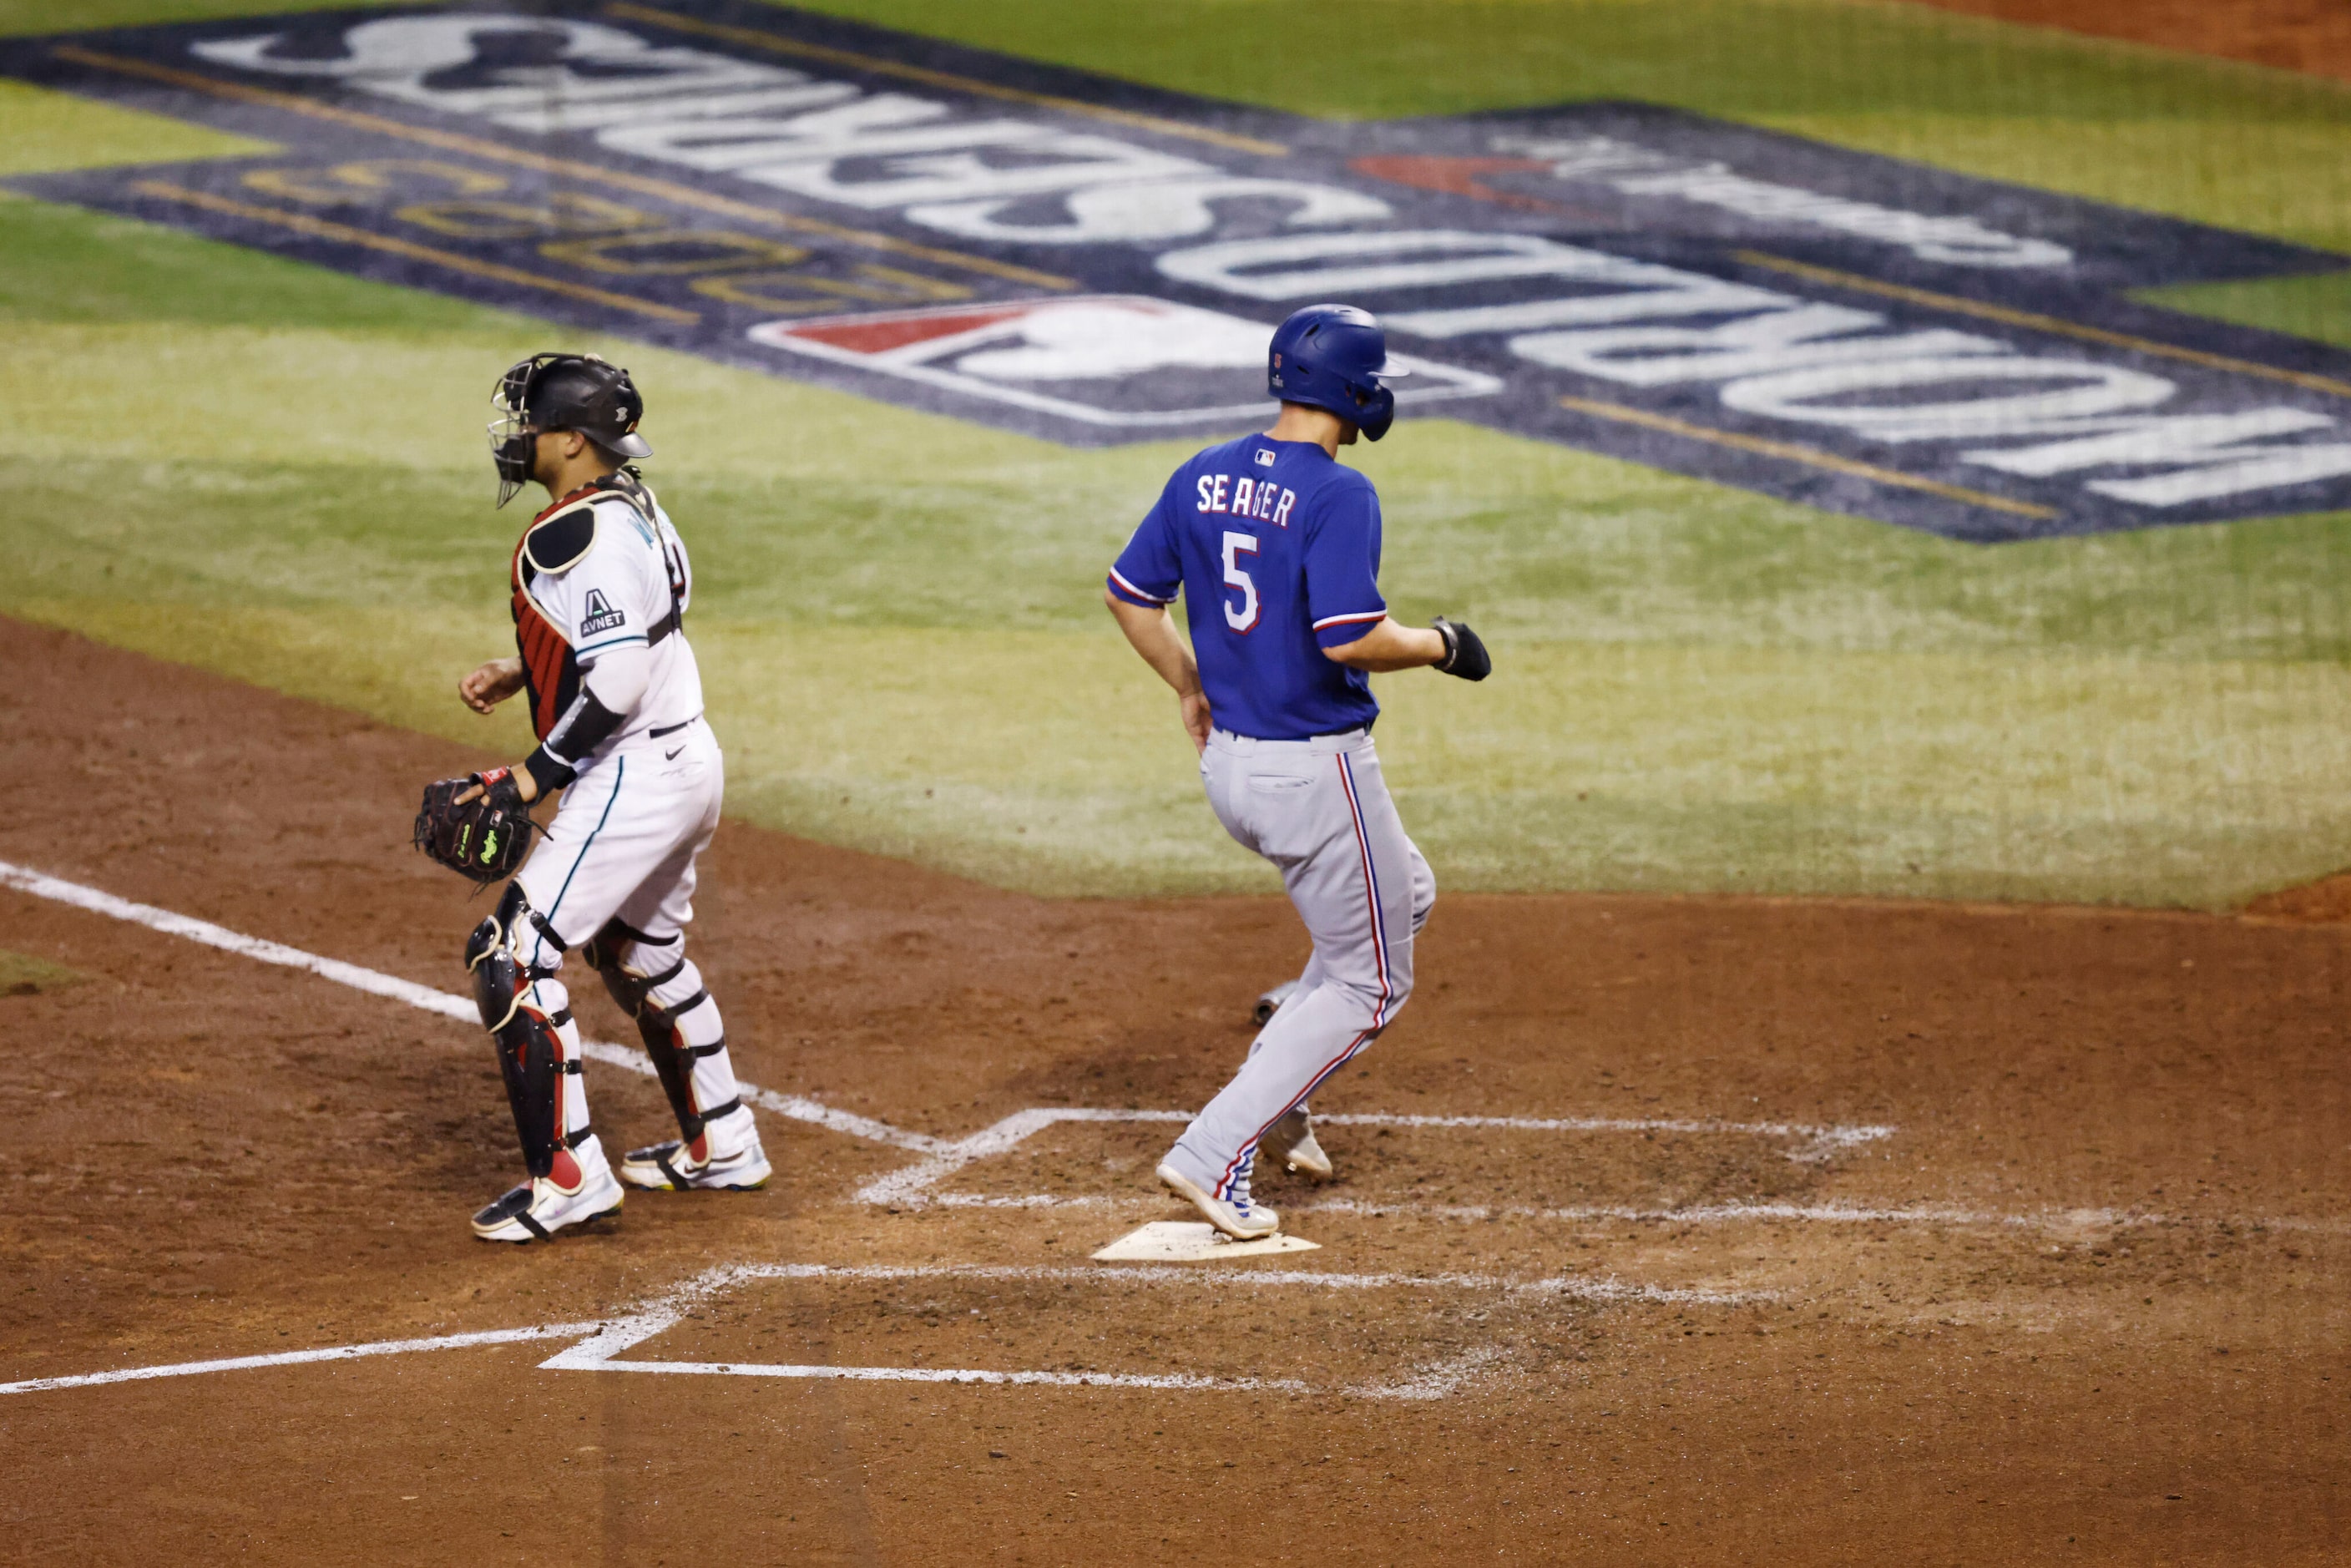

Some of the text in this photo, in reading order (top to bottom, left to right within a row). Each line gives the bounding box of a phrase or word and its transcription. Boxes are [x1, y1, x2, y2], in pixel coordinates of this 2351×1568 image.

[190, 13, 1394, 243] SERIES
[240, 159, 975, 313] 2023
[1155, 229, 2351, 507] WORLD
[1196, 473, 1296, 530] SEAGER
[582, 612, 623, 635] AVNET
[1221, 530, 1261, 636] 5
